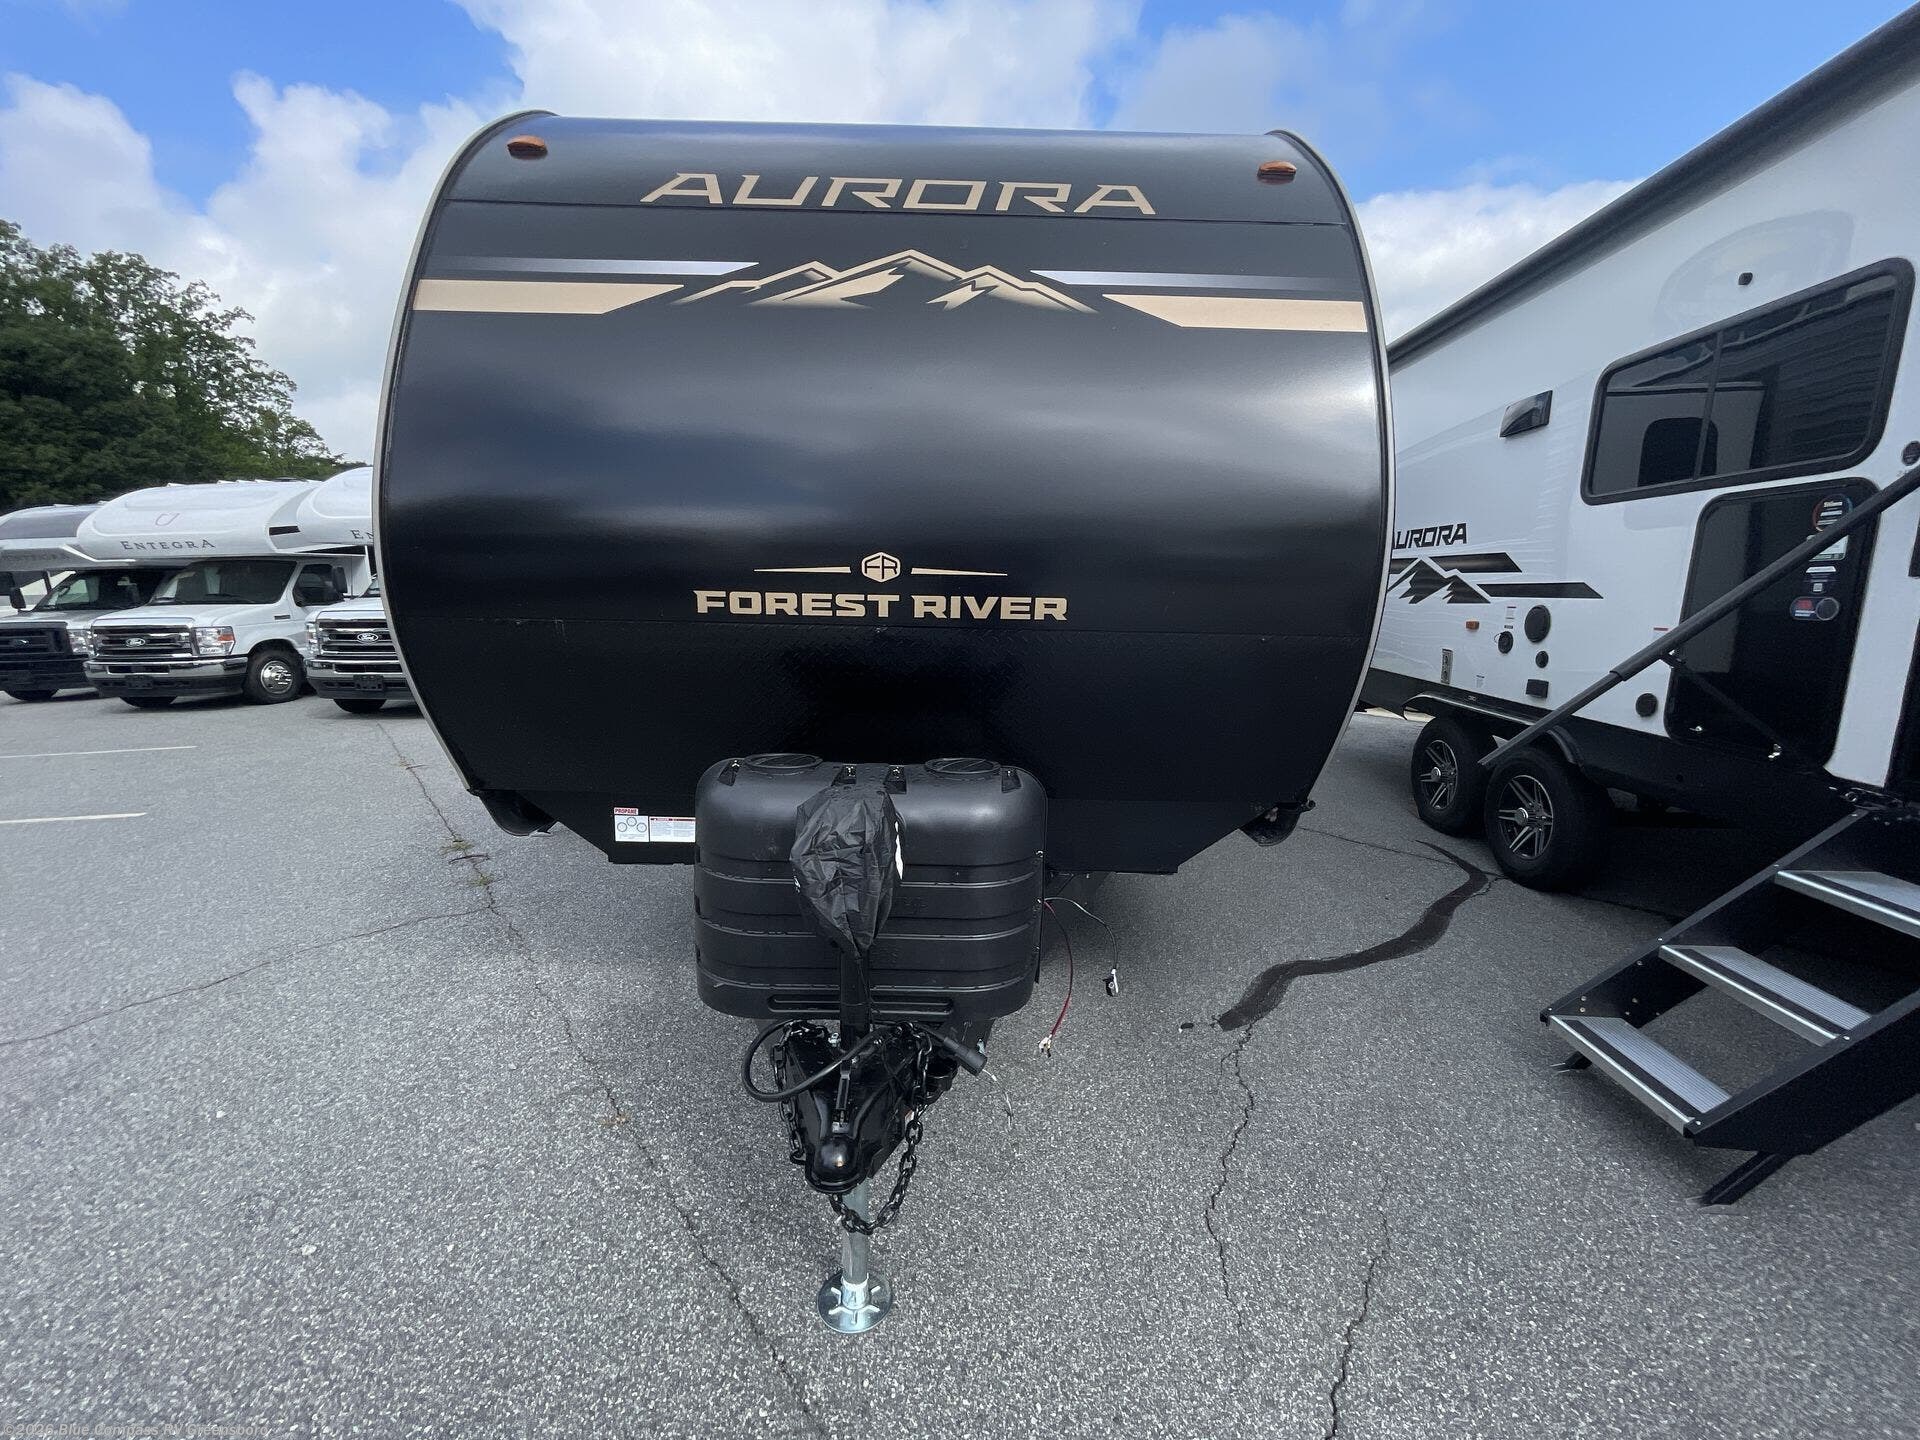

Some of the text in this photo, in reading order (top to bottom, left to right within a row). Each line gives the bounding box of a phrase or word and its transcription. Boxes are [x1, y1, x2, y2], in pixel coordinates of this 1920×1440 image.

[640, 172, 1156, 215] AURORA
[120, 538, 217, 551] ENTEGRA
[693, 589, 1068, 621] FOREST RIVER
